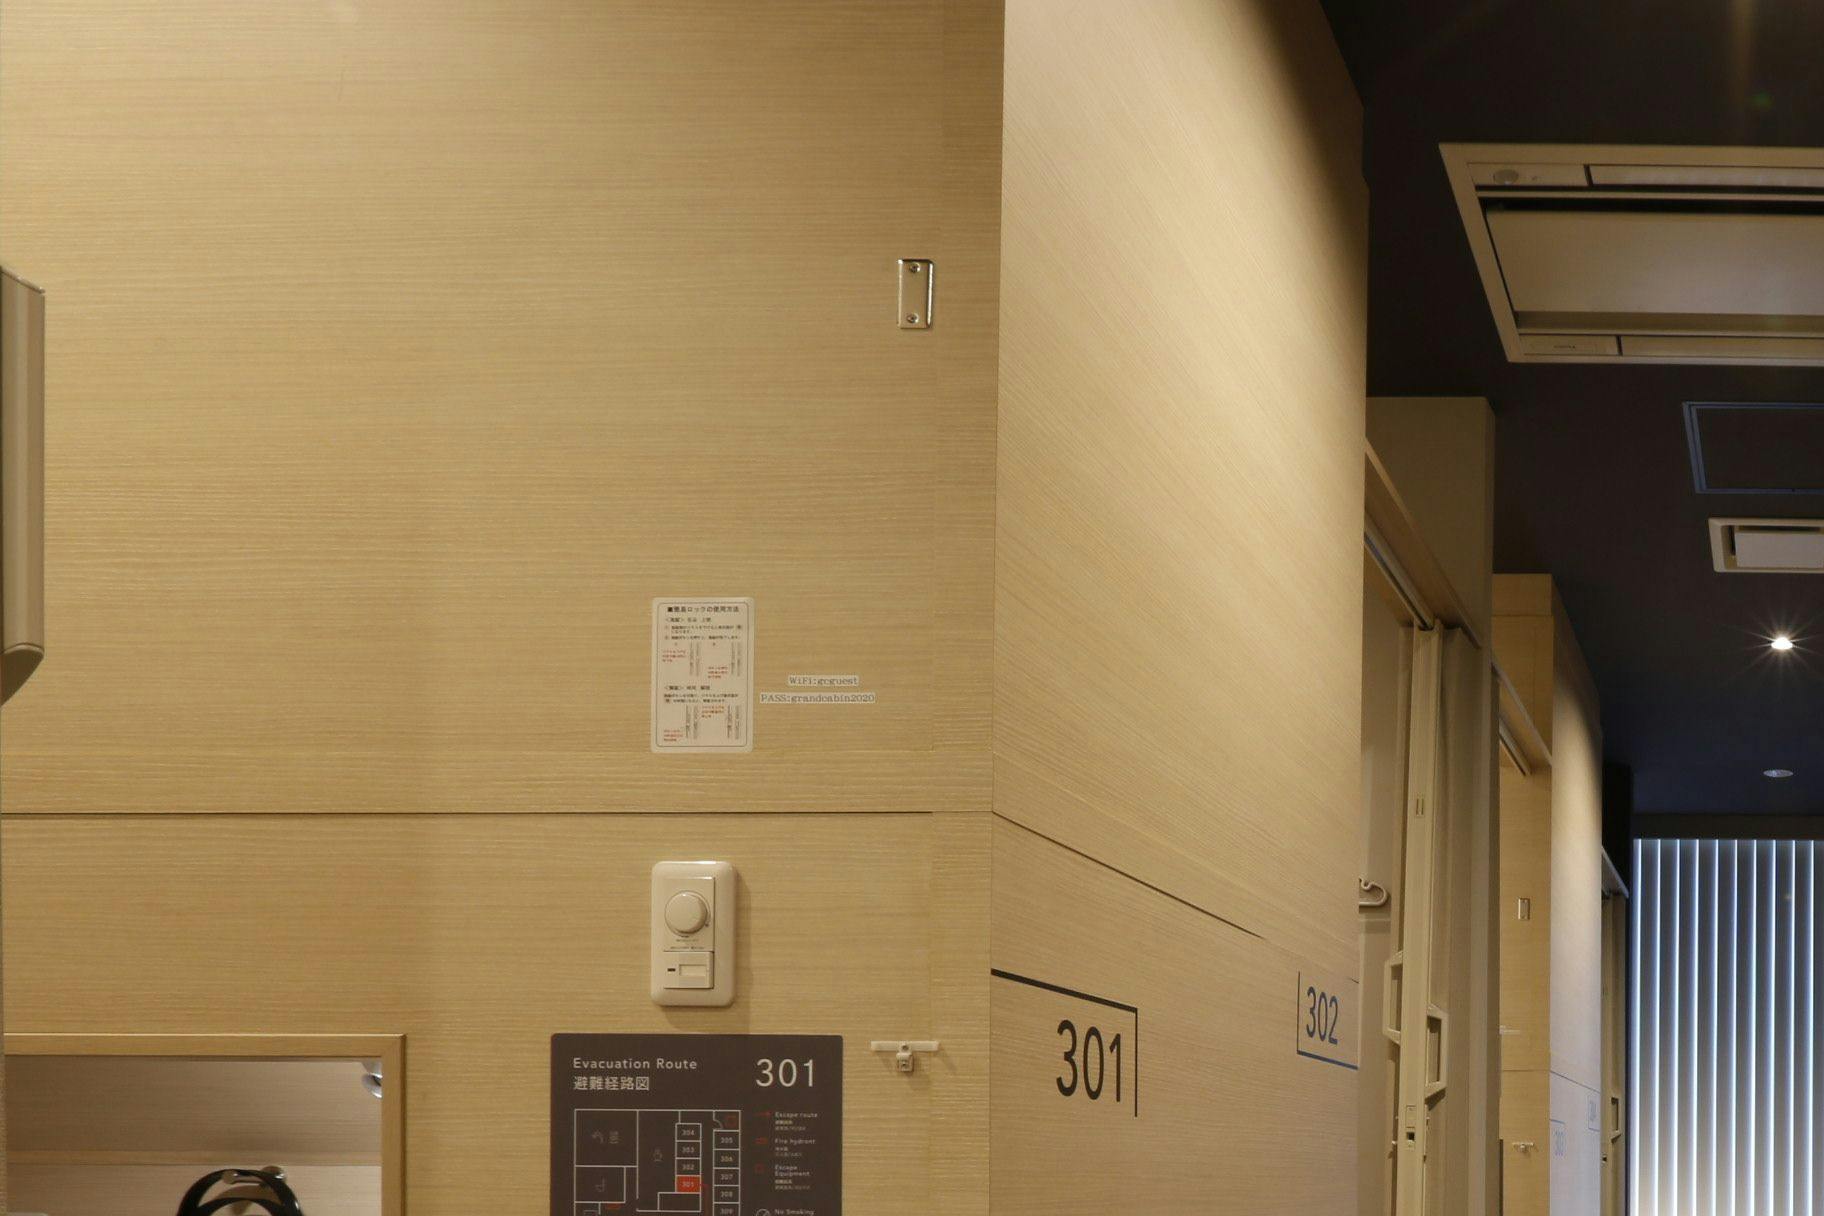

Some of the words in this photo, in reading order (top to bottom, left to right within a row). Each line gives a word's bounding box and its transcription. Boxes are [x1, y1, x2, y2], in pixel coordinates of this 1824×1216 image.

[1305, 986, 1339, 1045] 302
[573, 1057, 650, 1069] Evacuation
[656, 1058, 698, 1070] Route
[755, 1058, 815, 1088] 301
[1055, 1019, 1122, 1103] 301
[573, 1075, 651, 1091] 避難経路図
